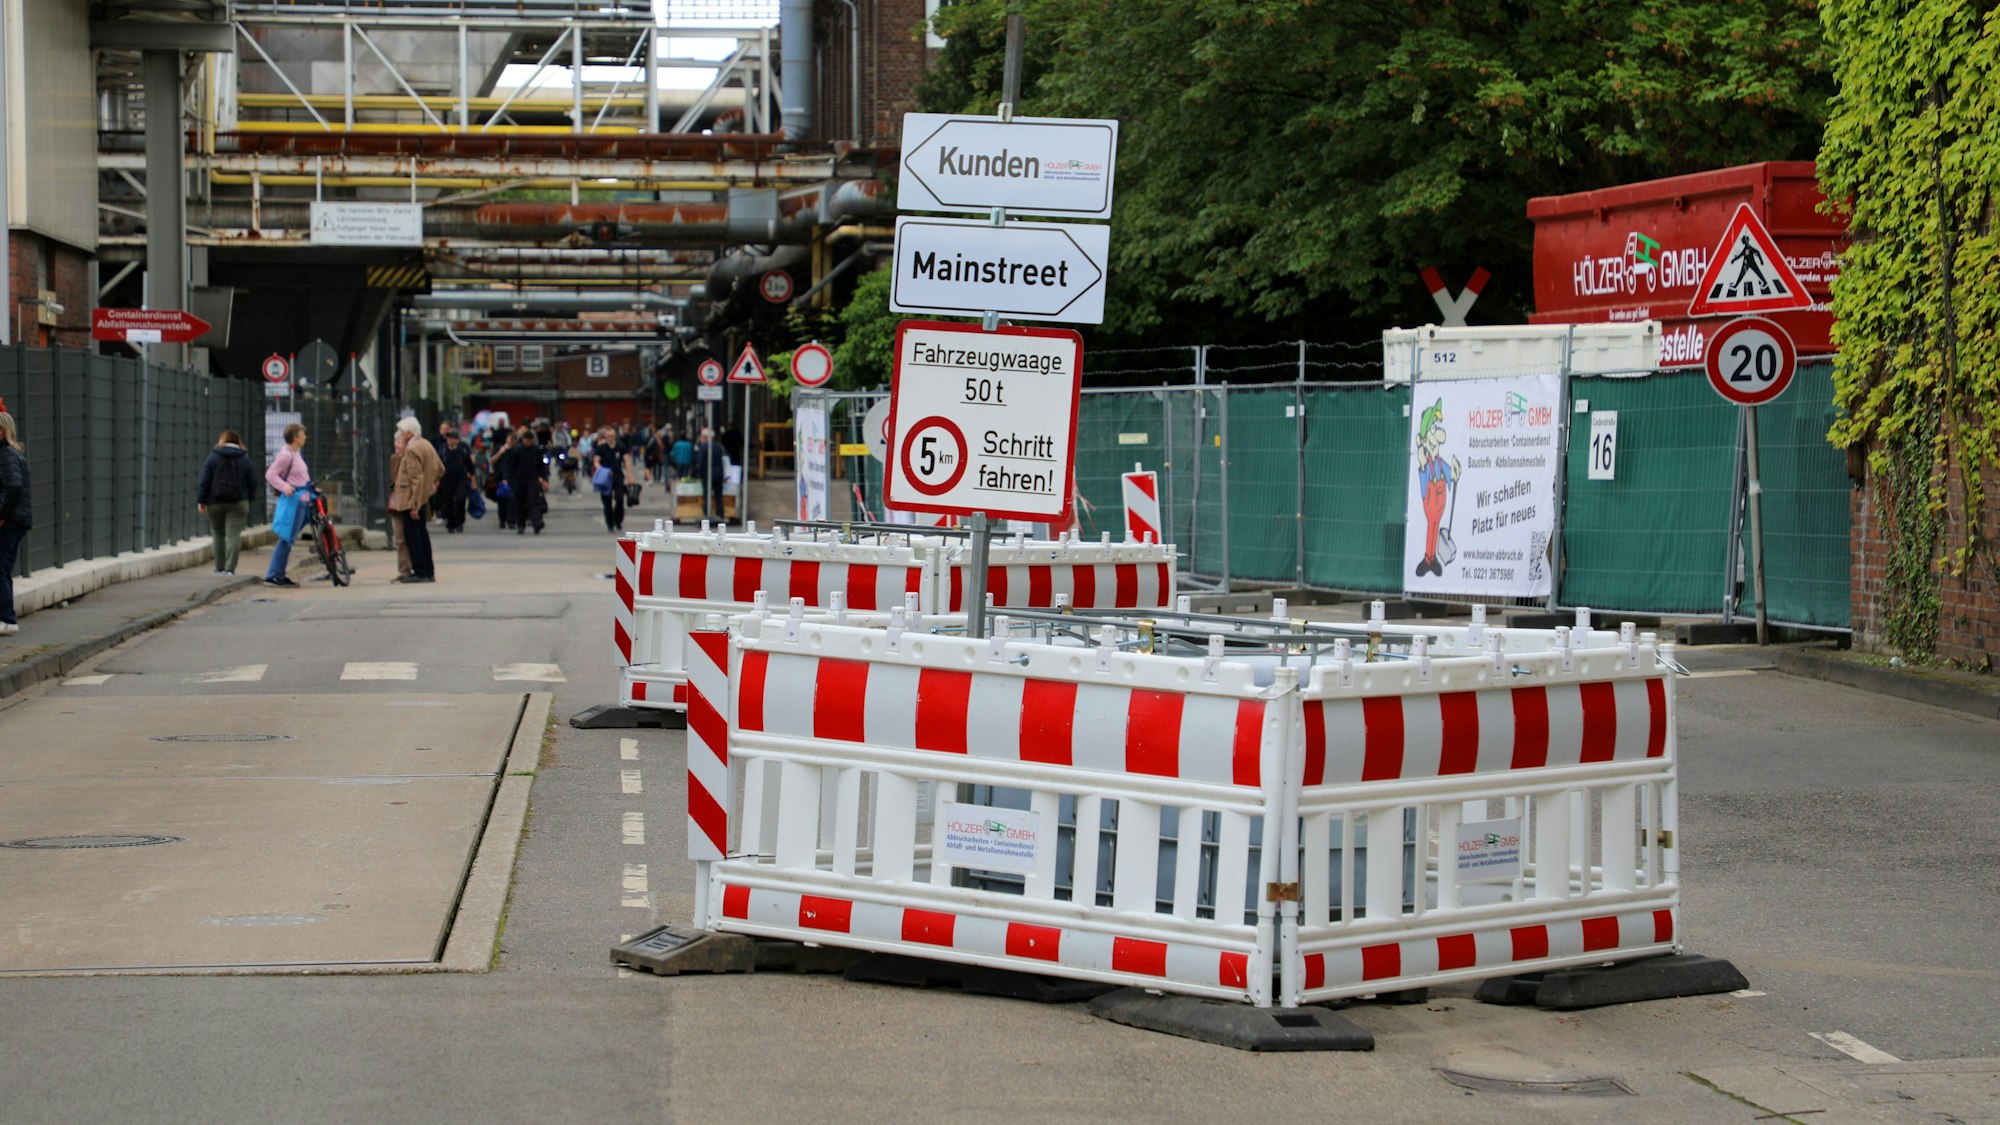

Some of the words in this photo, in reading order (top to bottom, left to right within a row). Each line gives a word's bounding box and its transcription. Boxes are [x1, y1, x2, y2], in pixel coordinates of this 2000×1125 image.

[939, 146, 1040, 178] Kunden
[912, 251, 1068, 287] Mainstreet
[1573, 254, 1624, 296] HÖLZER
[1661, 247, 1707, 288] GMBH
[1785, 256, 1820, 269] ÖLZER
[97, 319, 192, 331] Abfallannahmestelle
[108, 309, 182, 320] Containerdienst
[1660, 324, 1704, 362] estelle
[592, 356, 604, 373] B
[913, 342, 1062, 375] Fahrzeugwaage
[1434, 352, 1456, 363] 512
[1731, 344, 1777, 382] 20
[965, 378, 991, 401] 50
[997, 380, 1004, 403] t
[1469, 407, 1503, 428] HÖLZER
[1528, 406, 1552, 426] GMBH
[983, 430, 1053, 458] Schritt
[1469, 435, 1509, 448] Abbrucharbeiten
[1593, 433, 1612, 471] 16
[920, 436, 937, 475] 5
[939, 451, 953, 464] km
[1468, 456, 1492, 469] Baustoffe
[979, 464, 1053, 492] fahren!
[1476, 490, 1491, 509] Wir
[1493, 480, 1531, 504] schaffen
[1472, 516, 1493, 536] Platz
[1496, 511, 1508, 529] für
[1511, 505, 1536, 525] neues
[1462, 567, 1472, 579] Tel.
[1474, 567, 1488, 580] 0221
[946, 834, 989, 845] Abbrucharbeiten
[994, 839, 1034, 850] Containerdienst
[947, 820, 982, 834] HÖLZER
[1006, 828, 1035, 841] GMBH
[977, 846, 1034, 859] Metallannahmestelle
